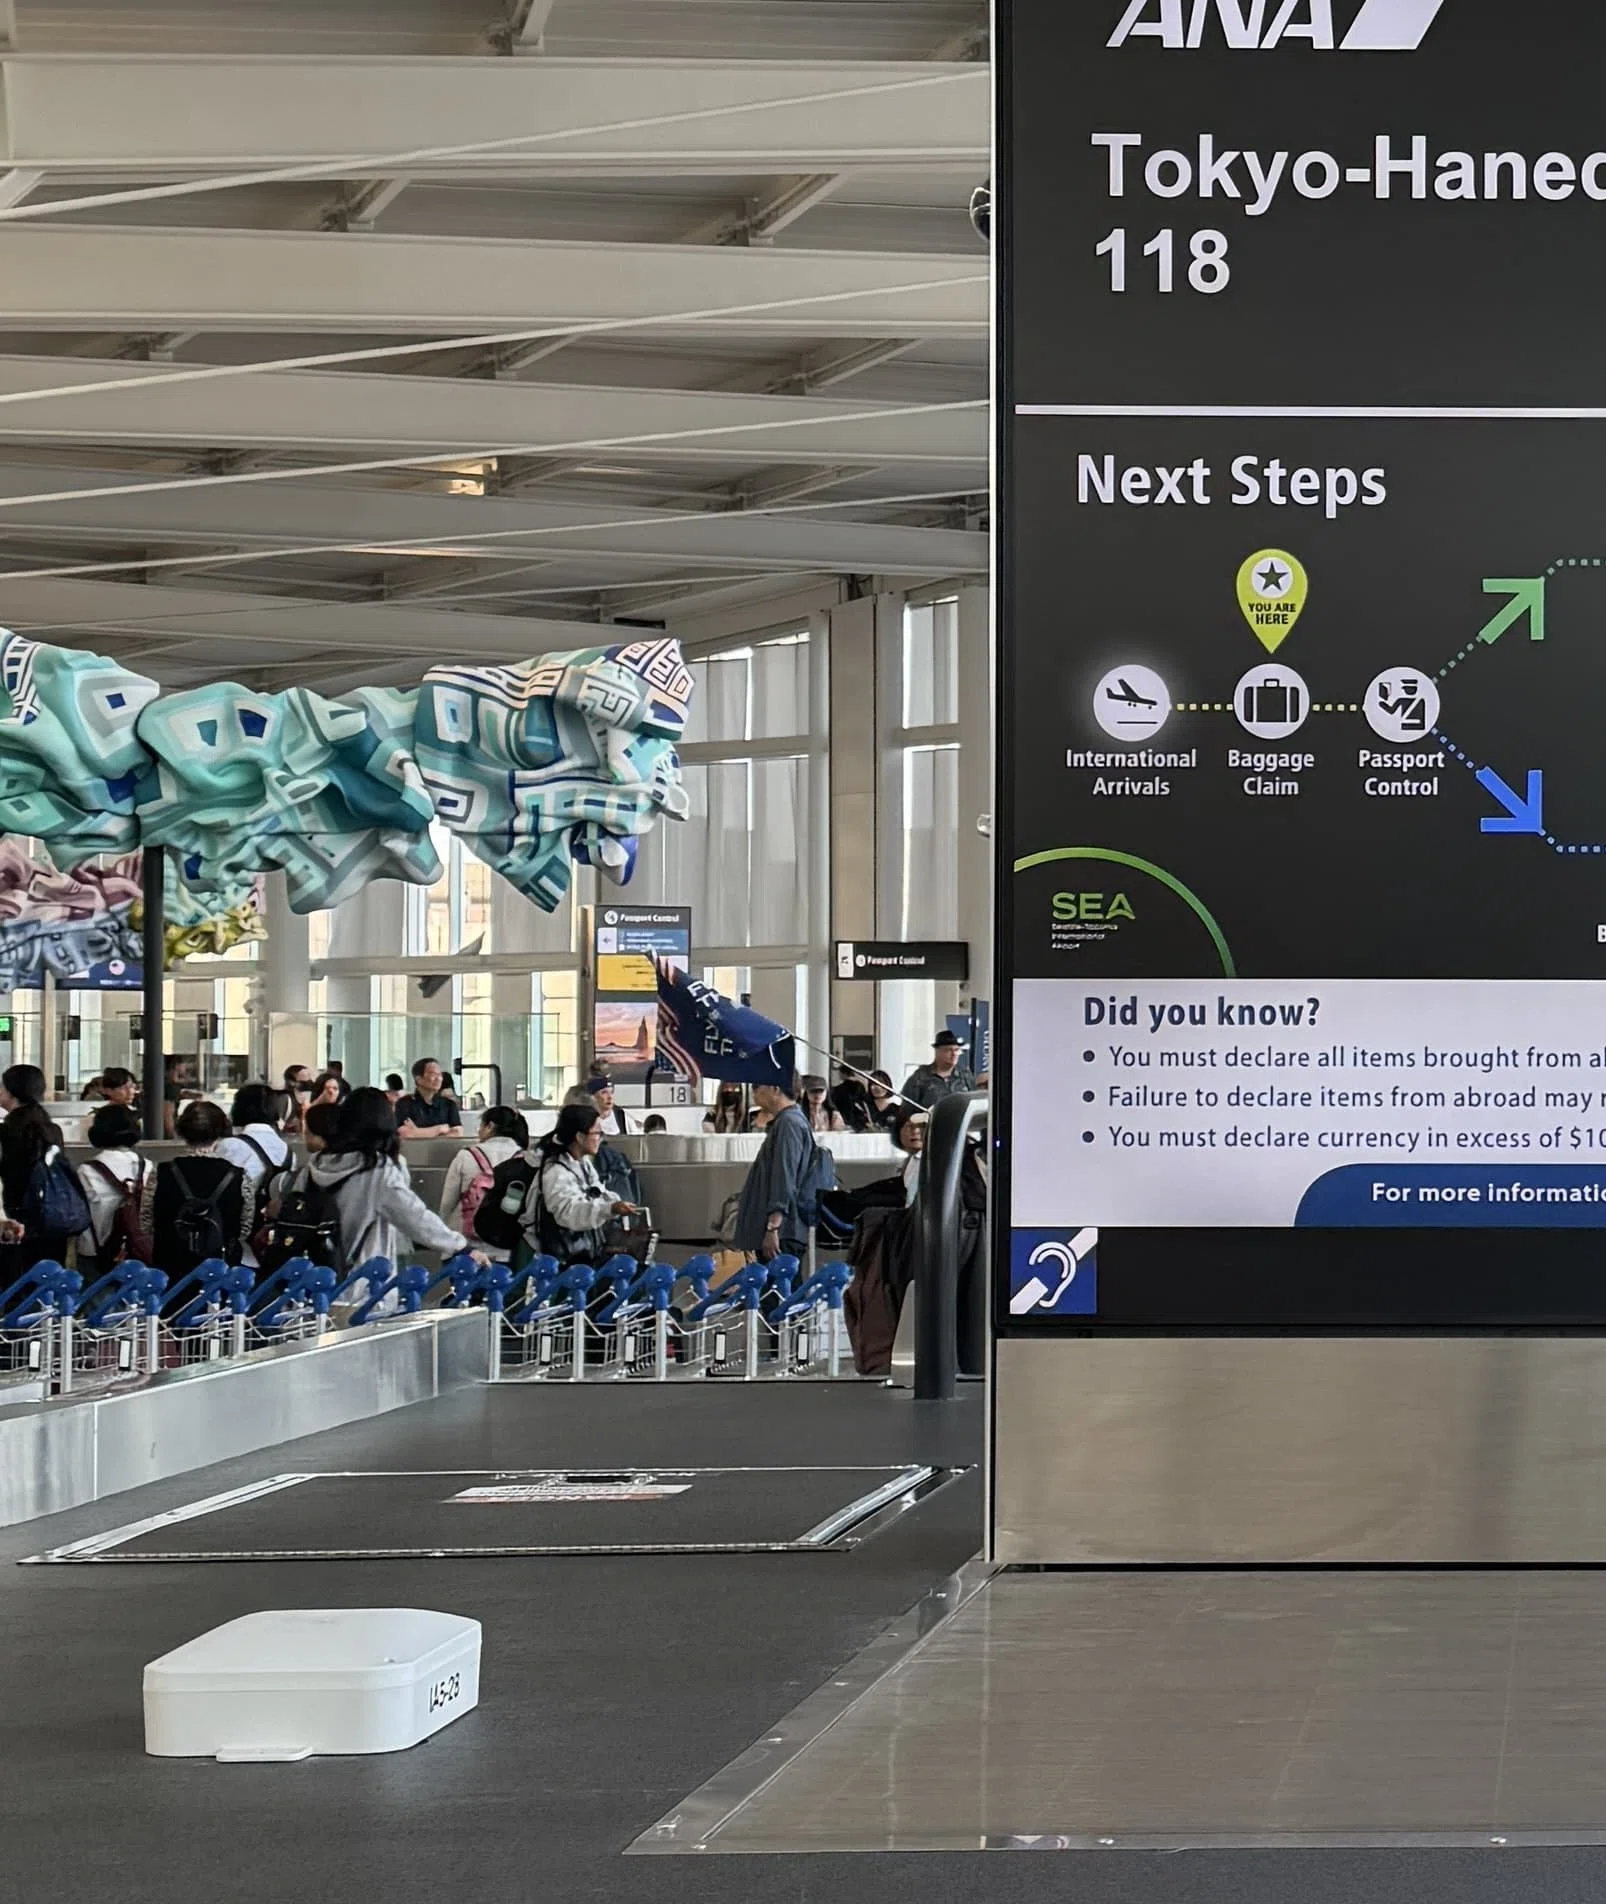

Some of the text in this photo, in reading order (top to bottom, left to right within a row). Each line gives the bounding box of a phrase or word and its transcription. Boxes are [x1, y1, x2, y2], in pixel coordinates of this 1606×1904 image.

[1095, 228, 1230, 294] 118
[1078, 454, 1386, 519] Next Steps
[1247, 603, 1297, 613] YOU ARE
[1255, 613, 1289, 625] HERE
[1066, 748, 1197, 768] International
[1228, 749, 1315, 772] Baggage
[1359, 749, 1445, 773] Passport
[1092, 776, 1170, 795] Arrivals
[1243, 775, 1299, 795] Claim
[1364, 776, 1438, 796] Control
[1052, 892, 1136, 920] SEA
[1084, 995, 1320, 1034] Did you know?
[1108, 1045, 1151, 1067] You
[1159, 1048, 1217, 1067] must
[1225, 1045, 1310, 1068] declare
[1318, 1045, 1345, 1067] all
[1353, 1046, 1416, 1068] items
[1424, 1045, 1519, 1074] brought
[1526, 1046, 1581, 1068] from
[669, 1086, 687, 1104] 18
[1109, 1084, 1188, 1107] Failure
[1195, 1088, 1219, 1107] to
[1227, 1085, 1312, 1107] declare
[1320, 1085, 1383, 1108] items
[1391, 1085, 1445, 1107] from
[1453, 1085, 1536, 1108] abroad
[1545, 1092, 1593, 1114] may
[1108, 1125, 1150, 1148] You
[1159, 1128, 1217, 1148] must
[1224, 1125, 1310, 1148] declare
[1318, 1131, 1420, 1153] currency
[1428, 1126, 1448, 1148] in
[1456, 1132, 1531, 1148] excess
[1539, 1126, 1563, 1148] of
[1372, 1182, 1412, 1202] For
[1418, 1187, 1481, 1202] more
